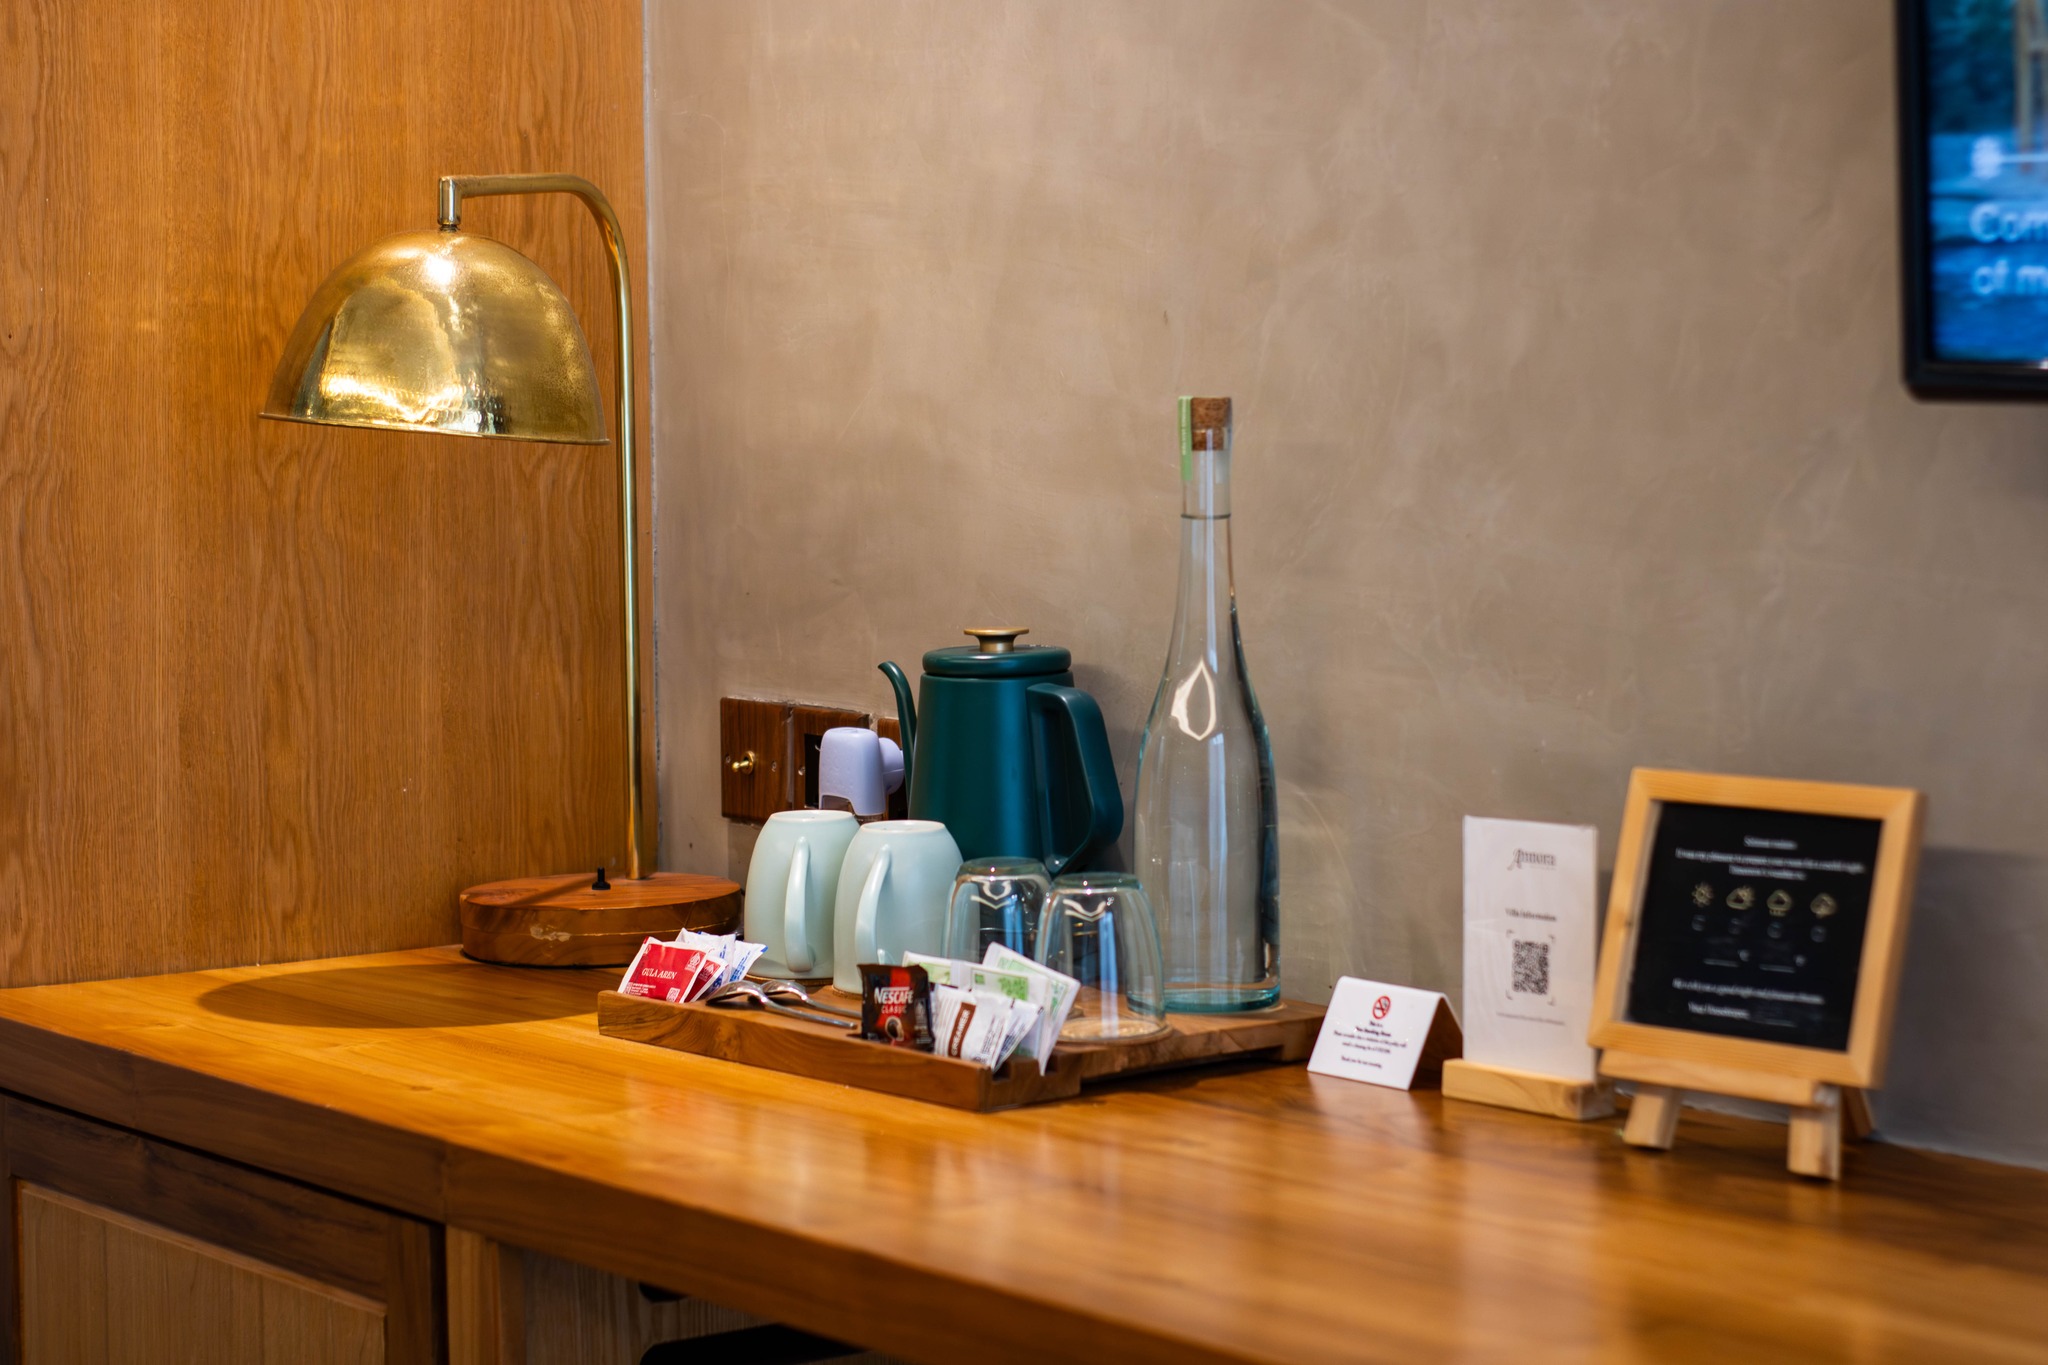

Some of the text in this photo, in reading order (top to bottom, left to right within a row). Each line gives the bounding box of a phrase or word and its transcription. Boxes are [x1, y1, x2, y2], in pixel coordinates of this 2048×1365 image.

[1972, 258, 2008, 294] of
[641, 968, 678, 980] GULA AREN
[951, 1009, 970, 1056] CREAMER
